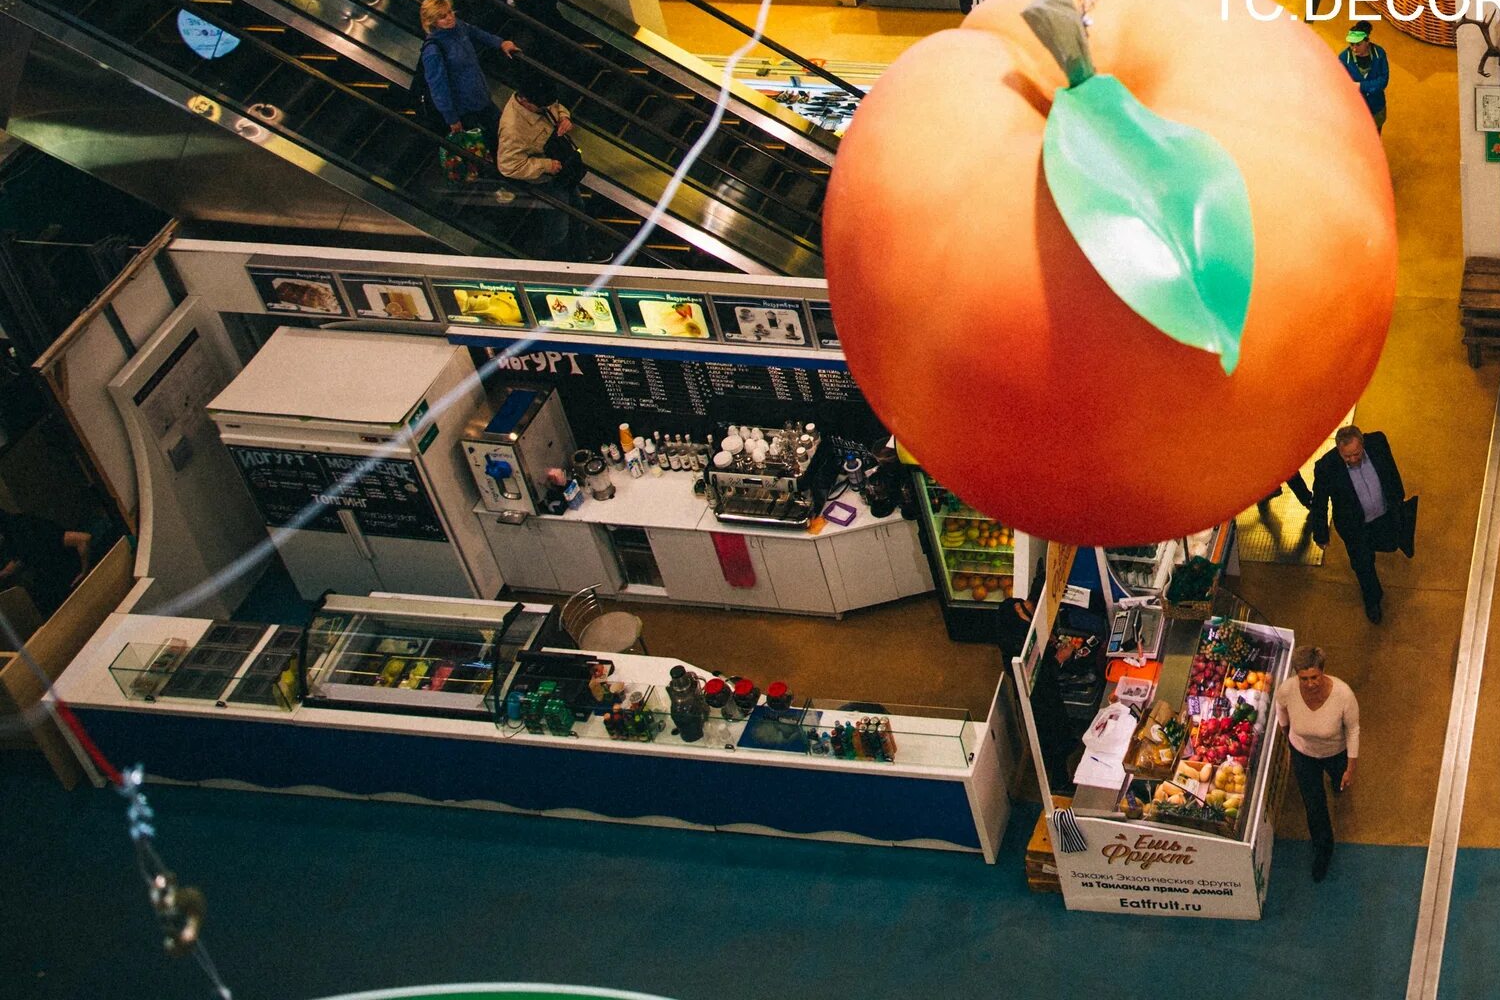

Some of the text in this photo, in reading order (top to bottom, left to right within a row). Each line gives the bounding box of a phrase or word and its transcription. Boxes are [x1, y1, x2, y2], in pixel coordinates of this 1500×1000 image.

[1134, 834, 1183, 852] Ешь
[1101, 843, 1195, 870] Фрукт
[1070, 870, 1242, 889] Закажи Экзотические фрукты
[1081, 880, 1095, 888] из
[1153, 885, 1189, 895] прямо
[1192, 886, 1233, 897] домой!
[1119, 897, 1202, 912] Eatfruit.ru
